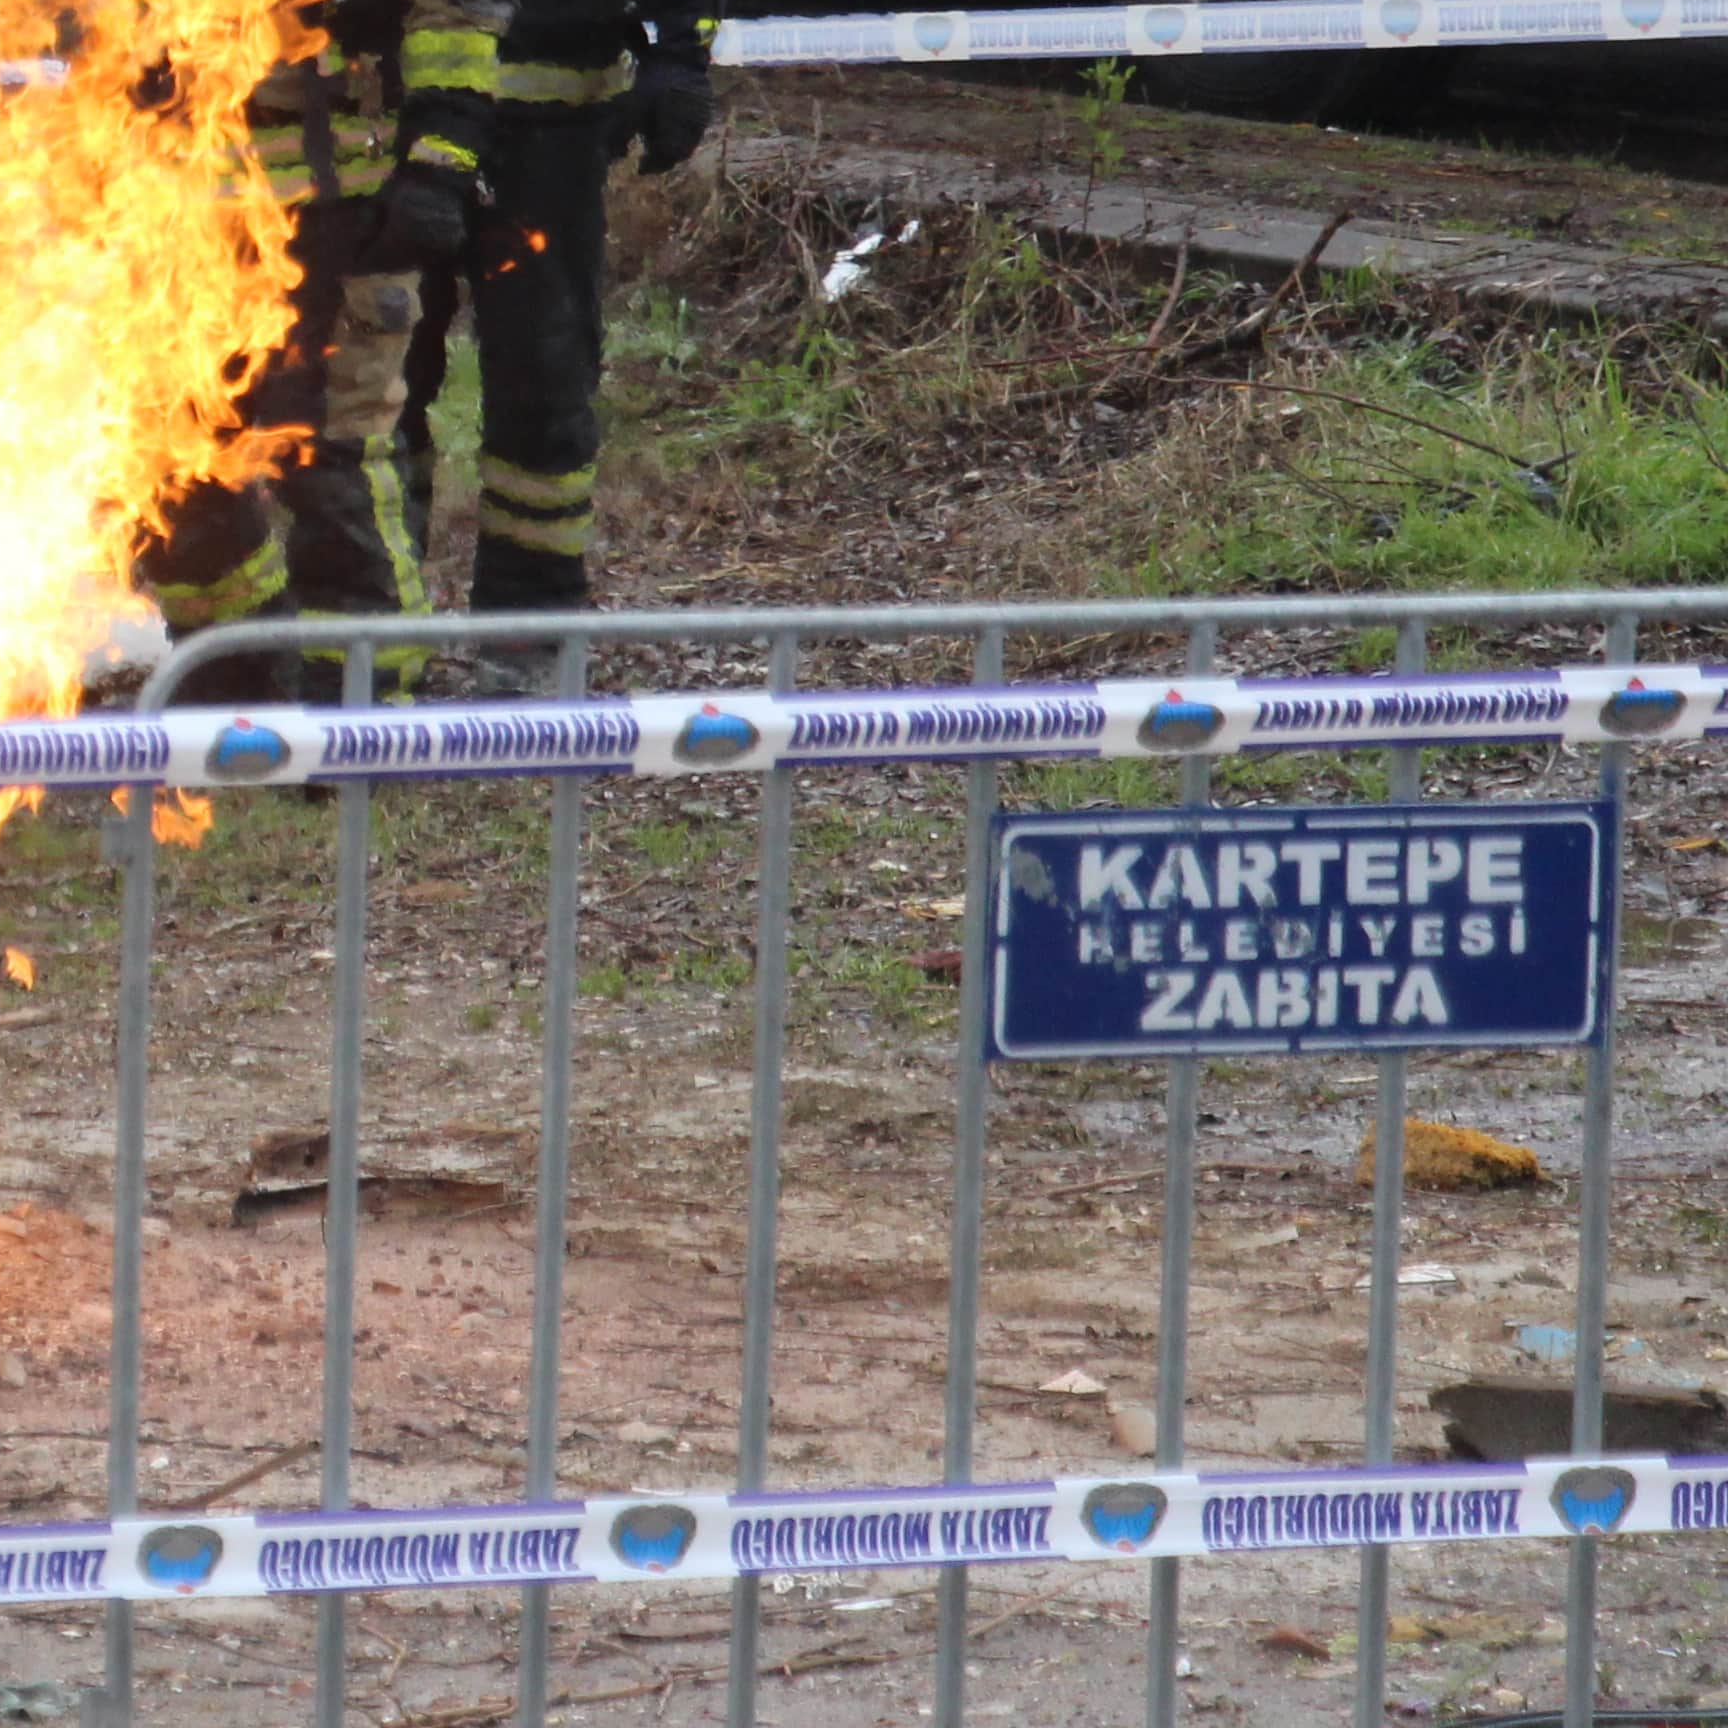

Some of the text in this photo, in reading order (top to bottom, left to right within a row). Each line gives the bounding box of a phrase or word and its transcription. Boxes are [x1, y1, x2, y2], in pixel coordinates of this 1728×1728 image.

[320, 724, 432, 767] ZABITA
[1078, 836, 1527, 913] KARTEPE
[1140, 965, 1450, 1032] ZABITA
[940, 1505, 1053, 1557] ZABITA
[1410, 1487, 1523, 1537] ZABITA
[468, 1526, 582, 1575] ZABITA
